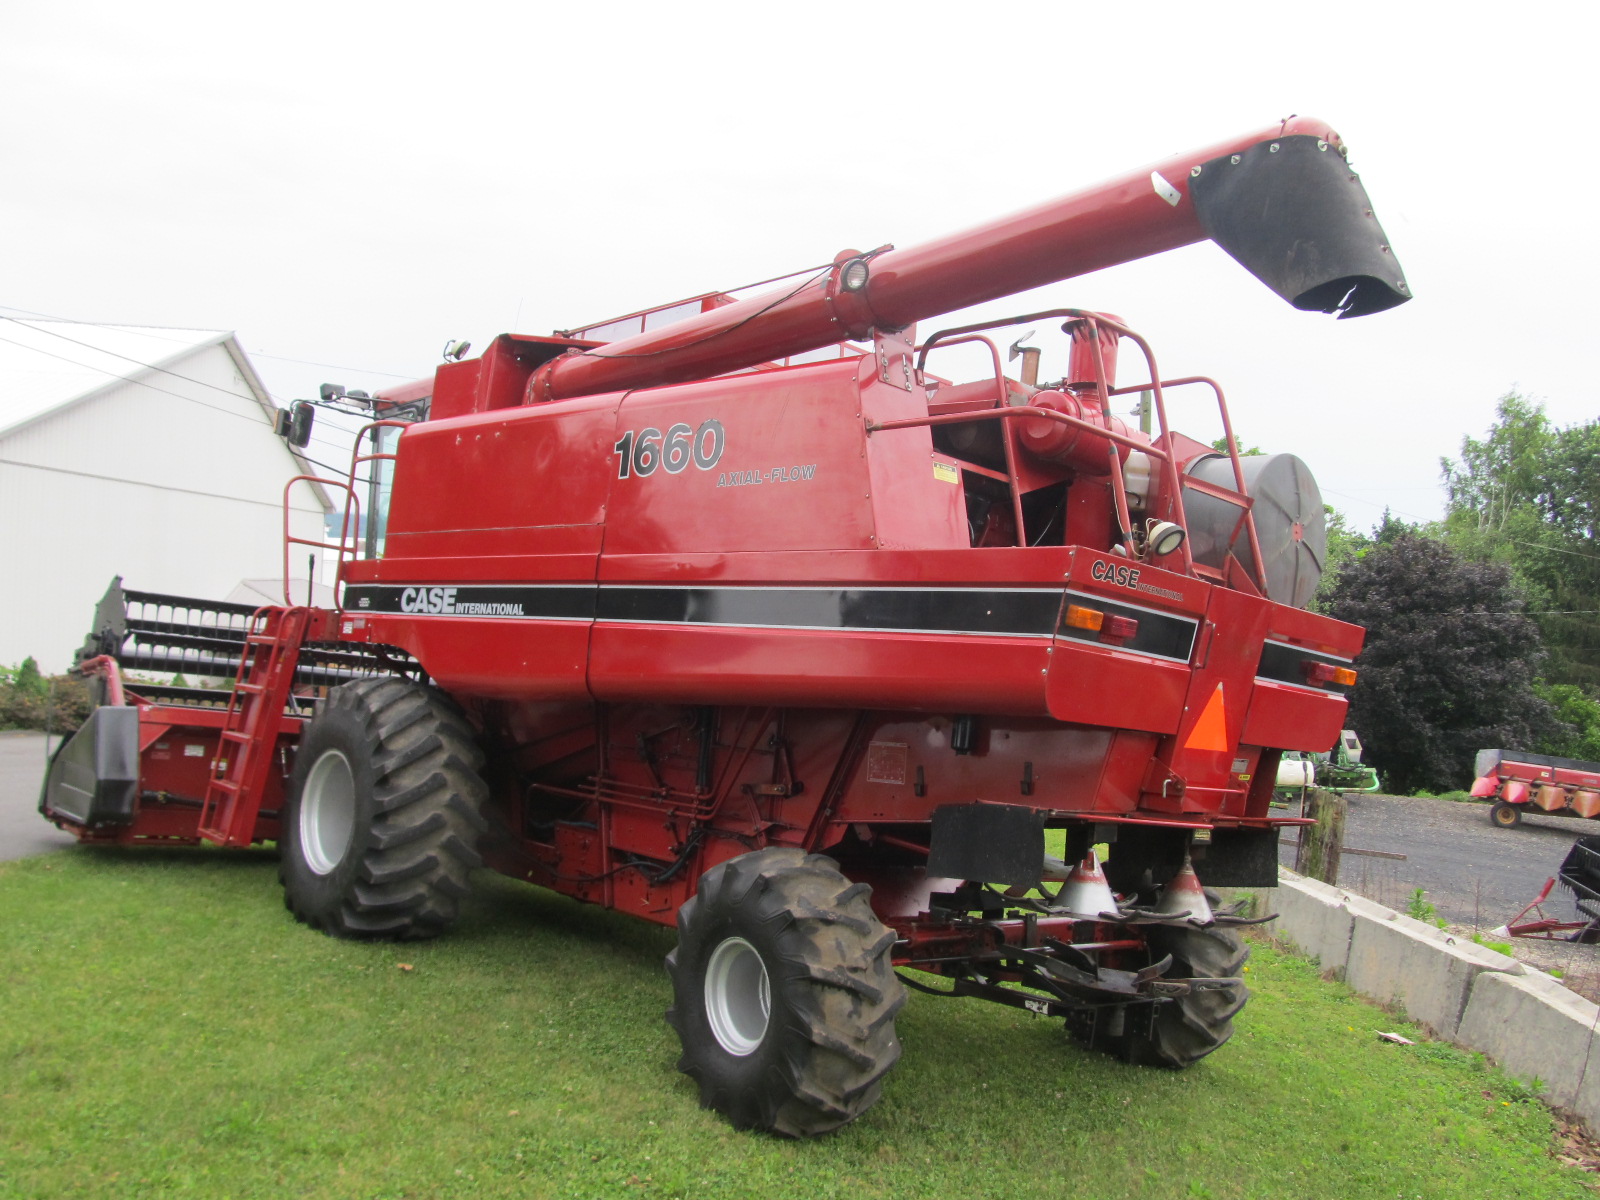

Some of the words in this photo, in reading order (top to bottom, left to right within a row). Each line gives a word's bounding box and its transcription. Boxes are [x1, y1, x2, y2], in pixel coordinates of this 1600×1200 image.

[614, 419, 725, 479] 1660
[717, 464, 816, 487] AXIAL-FLOW
[1091, 560, 1140, 589] CASE
[1137, 583, 1184, 602] INTERNATIONAL
[401, 588, 458, 613] CASE
[455, 603, 524, 615] INTERNATIONAL
